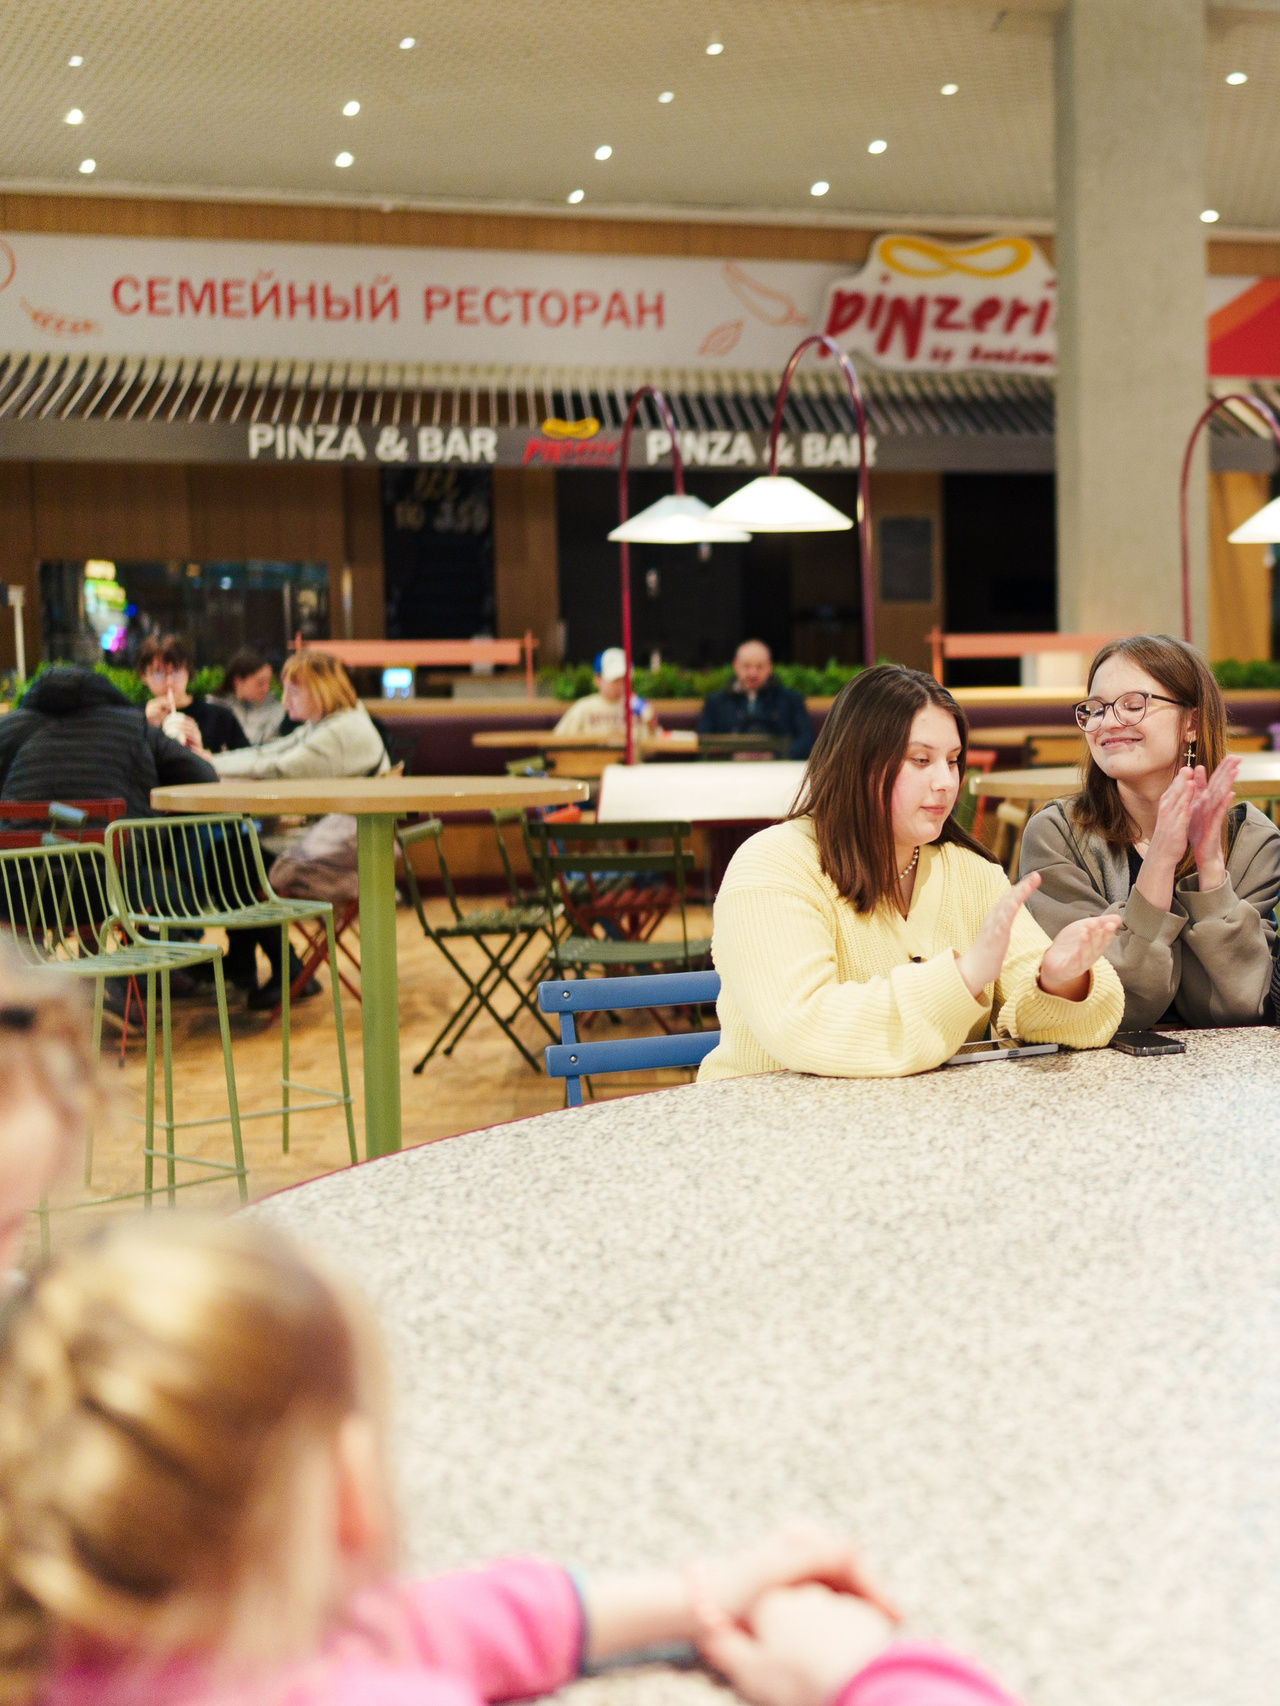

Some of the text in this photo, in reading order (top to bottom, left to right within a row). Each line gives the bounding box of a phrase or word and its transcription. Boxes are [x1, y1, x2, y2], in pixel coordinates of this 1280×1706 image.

[110, 269, 666, 329] СЕМЕЙНЫЙ РЕСТОРАН
[248, 424, 498, 464] PINZA & BAR
[801, 432, 877, 468] BAR
